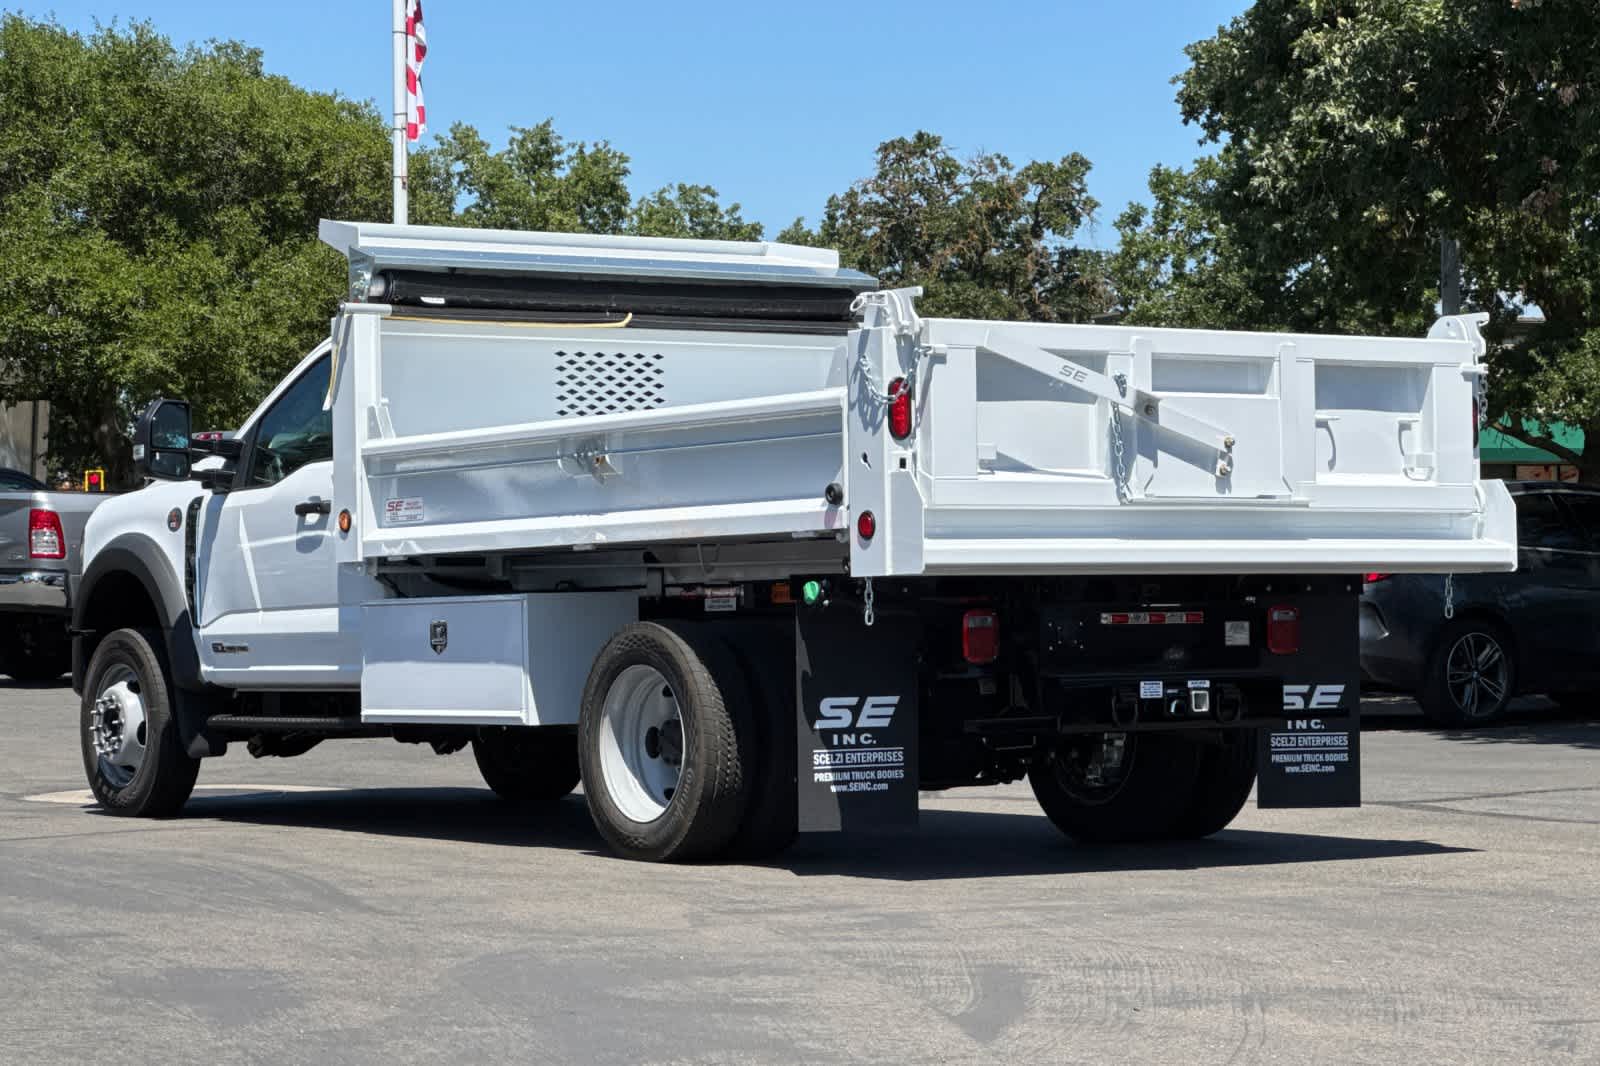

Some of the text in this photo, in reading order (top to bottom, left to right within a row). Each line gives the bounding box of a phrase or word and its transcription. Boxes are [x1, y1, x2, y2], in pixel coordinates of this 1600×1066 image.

[1059, 364, 1088, 383] SE
[386, 500, 404, 512] SE
[1283, 684, 1345, 710] SE
[813, 696, 900, 728] SE
[1287, 719, 1325, 729] INC.
[832, 733, 877, 745] INC.
[1271, 735, 1349, 747] SCELZI ENTERPRISES
[813, 751, 904, 765] SCELZI ENTERPRISES
[1271, 752, 1349, 763] PREMIUM TRUCK BODIES
[1285, 764, 1336, 773] www.SEINC.com
[814, 769, 904, 782] PREMIUM TRUCK BODIES
[830, 781, 888, 793] www.SEINC.com
